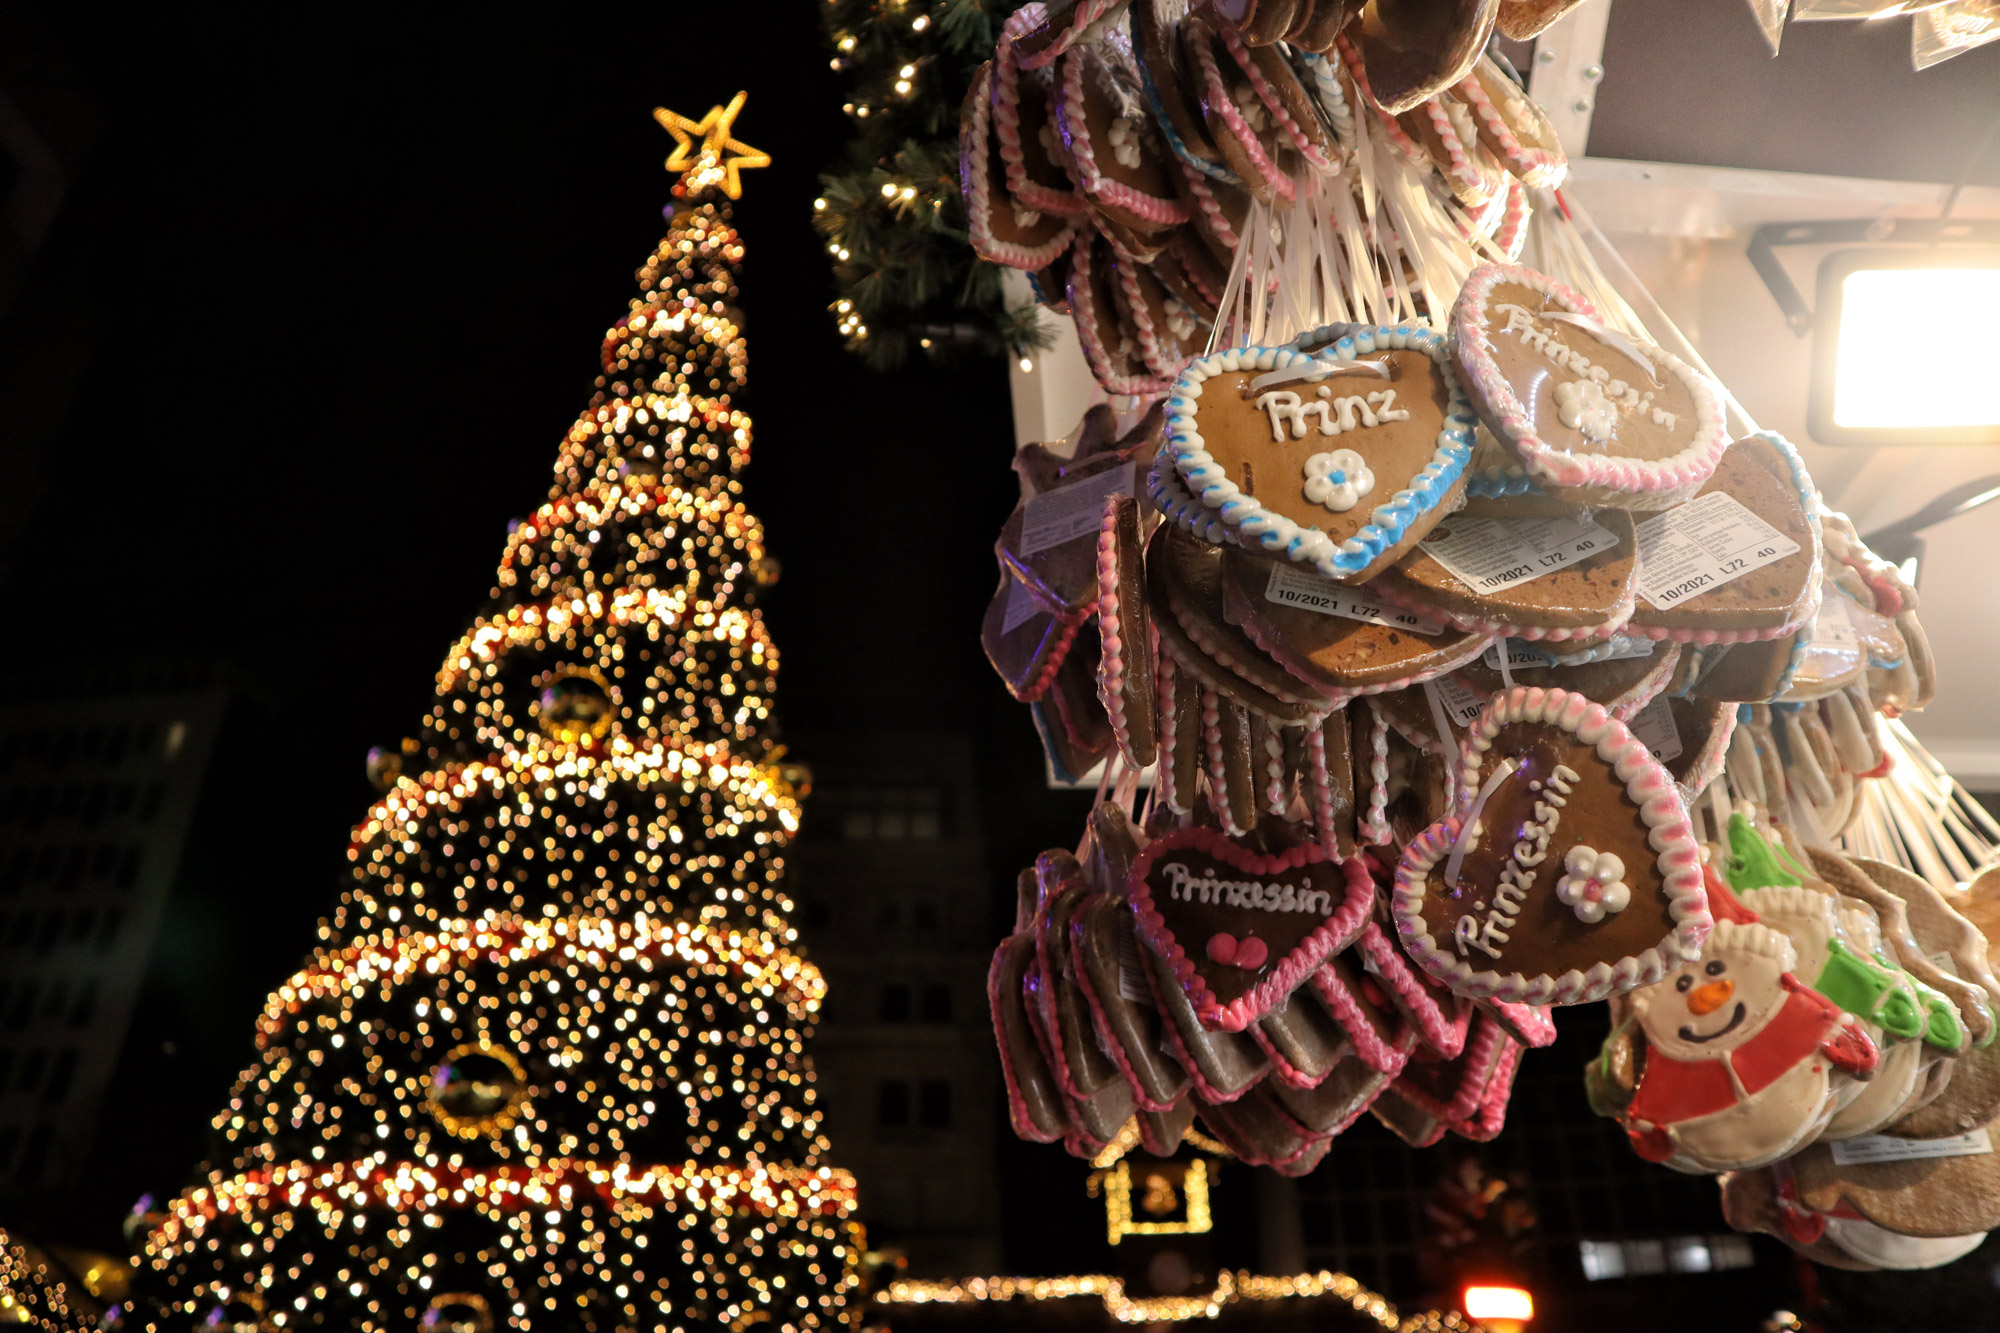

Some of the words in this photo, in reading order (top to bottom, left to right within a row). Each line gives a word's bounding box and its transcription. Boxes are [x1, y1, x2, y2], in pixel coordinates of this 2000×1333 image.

[1255, 385, 1410, 443] Prinz
[1478, 564, 1534, 589] 10/2021
[1538, 552, 1567, 568] L72
[1575, 540, 1596, 553] 40
[1658, 573, 1715, 602] 10/2021
[1719, 558, 1751, 575] L72
[1757, 547, 1777, 560] 40
[1278, 589, 1338, 610] 10/2021
[1351, 604, 1381, 618] L72
[1395, 613, 1418, 625] 40
[1161, 862, 1334, 917] Prinzessin
[1455, 764, 1582, 960] Prinzessin
